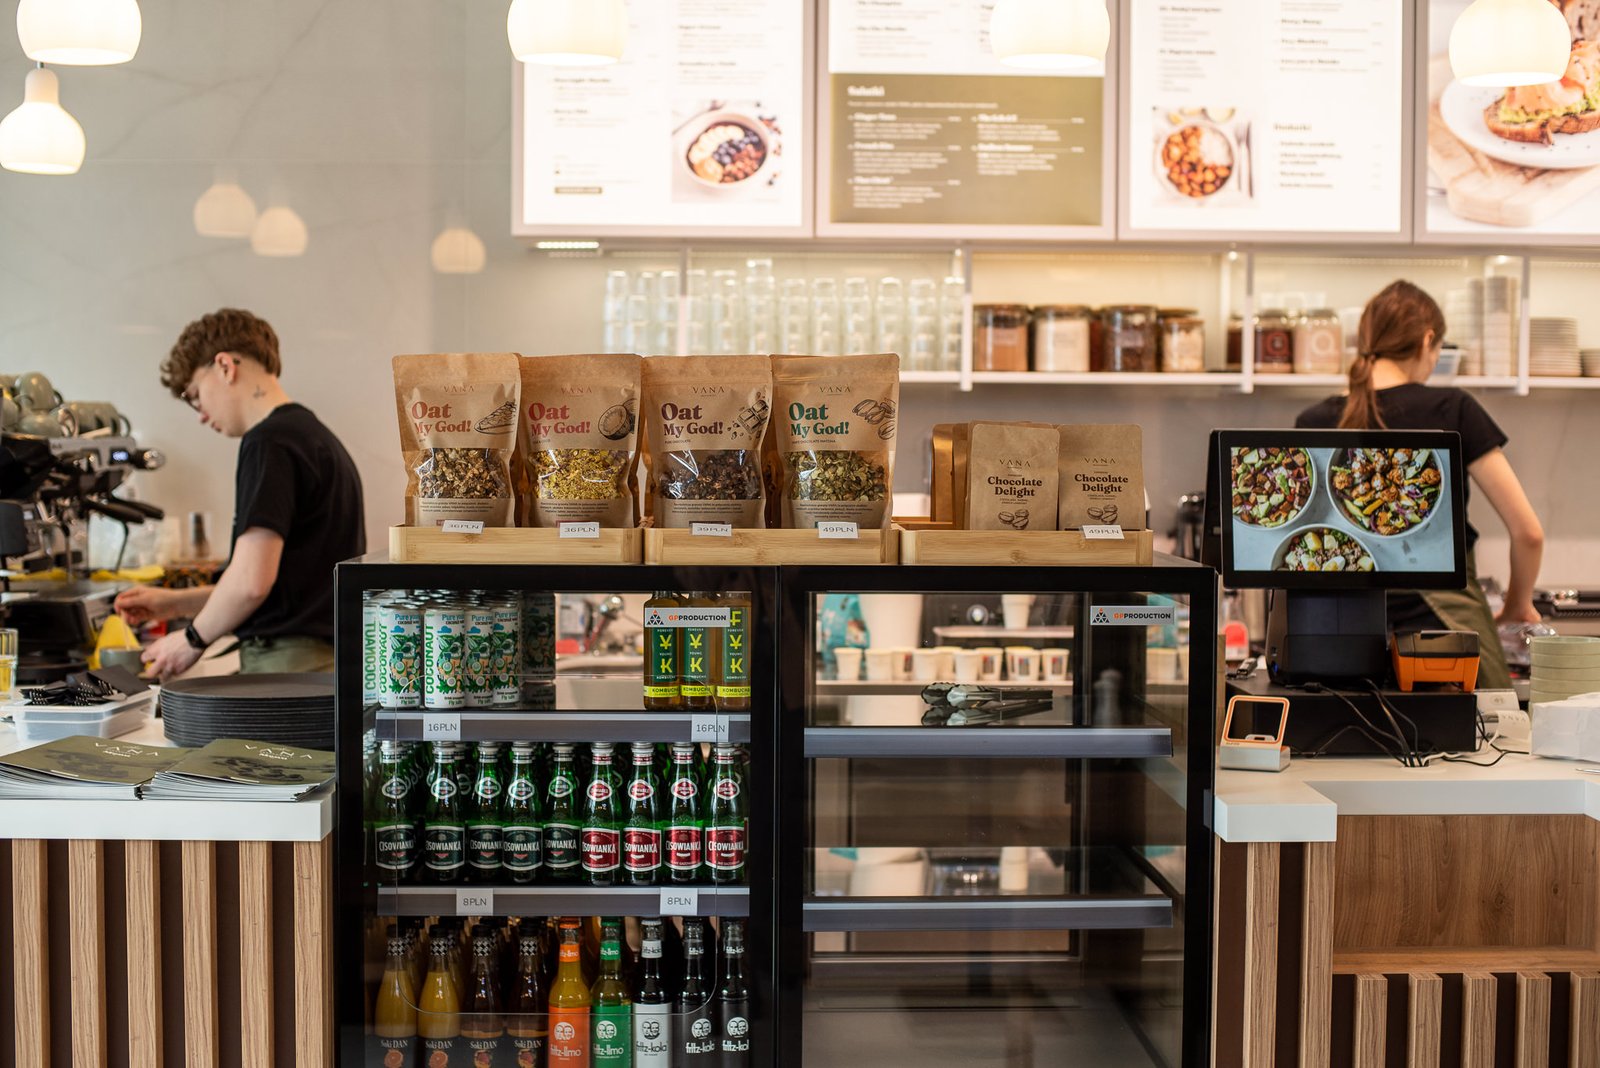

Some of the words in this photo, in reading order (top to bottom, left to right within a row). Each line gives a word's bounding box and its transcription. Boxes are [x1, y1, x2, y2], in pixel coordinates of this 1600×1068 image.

[692, 386, 725, 394] VANA
[820, 384, 852, 393] VANA
[411, 401, 452, 420] Oat
[528, 402, 570, 421] Oat
[661, 402, 702, 421] Oat
[788, 402, 829, 421] Oat
[434, 420, 472, 433] God!
[531, 422, 552, 438] My
[554, 421, 591, 434] God!
[663, 423, 685, 438] My
[686, 421, 724, 434] God!
[790, 423, 811, 438] My
[812, 421, 850, 434] God!
[1000, 459, 1032, 468] VANA
[987, 476, 1043, 487] Chocolate
[1074, 473, 1129, 484] Chocolate
[994, 486, 1036, 498] Delight
[1082, 483, 1123, 494] Delight
[379, 625, 388, 694] COCONAUT
[425, 625, 434, 694] COCONAUT
[428, 724, 456, 732] 16PLN
[696, 724, 726, 732] 16PLN
[245, 744, 312, 760] VANA
[462, 898, 487, 906] 8PLN
[667, 898, 692, 906] 8PLN
[722, 1040, 750, 1052] fritz-kol
